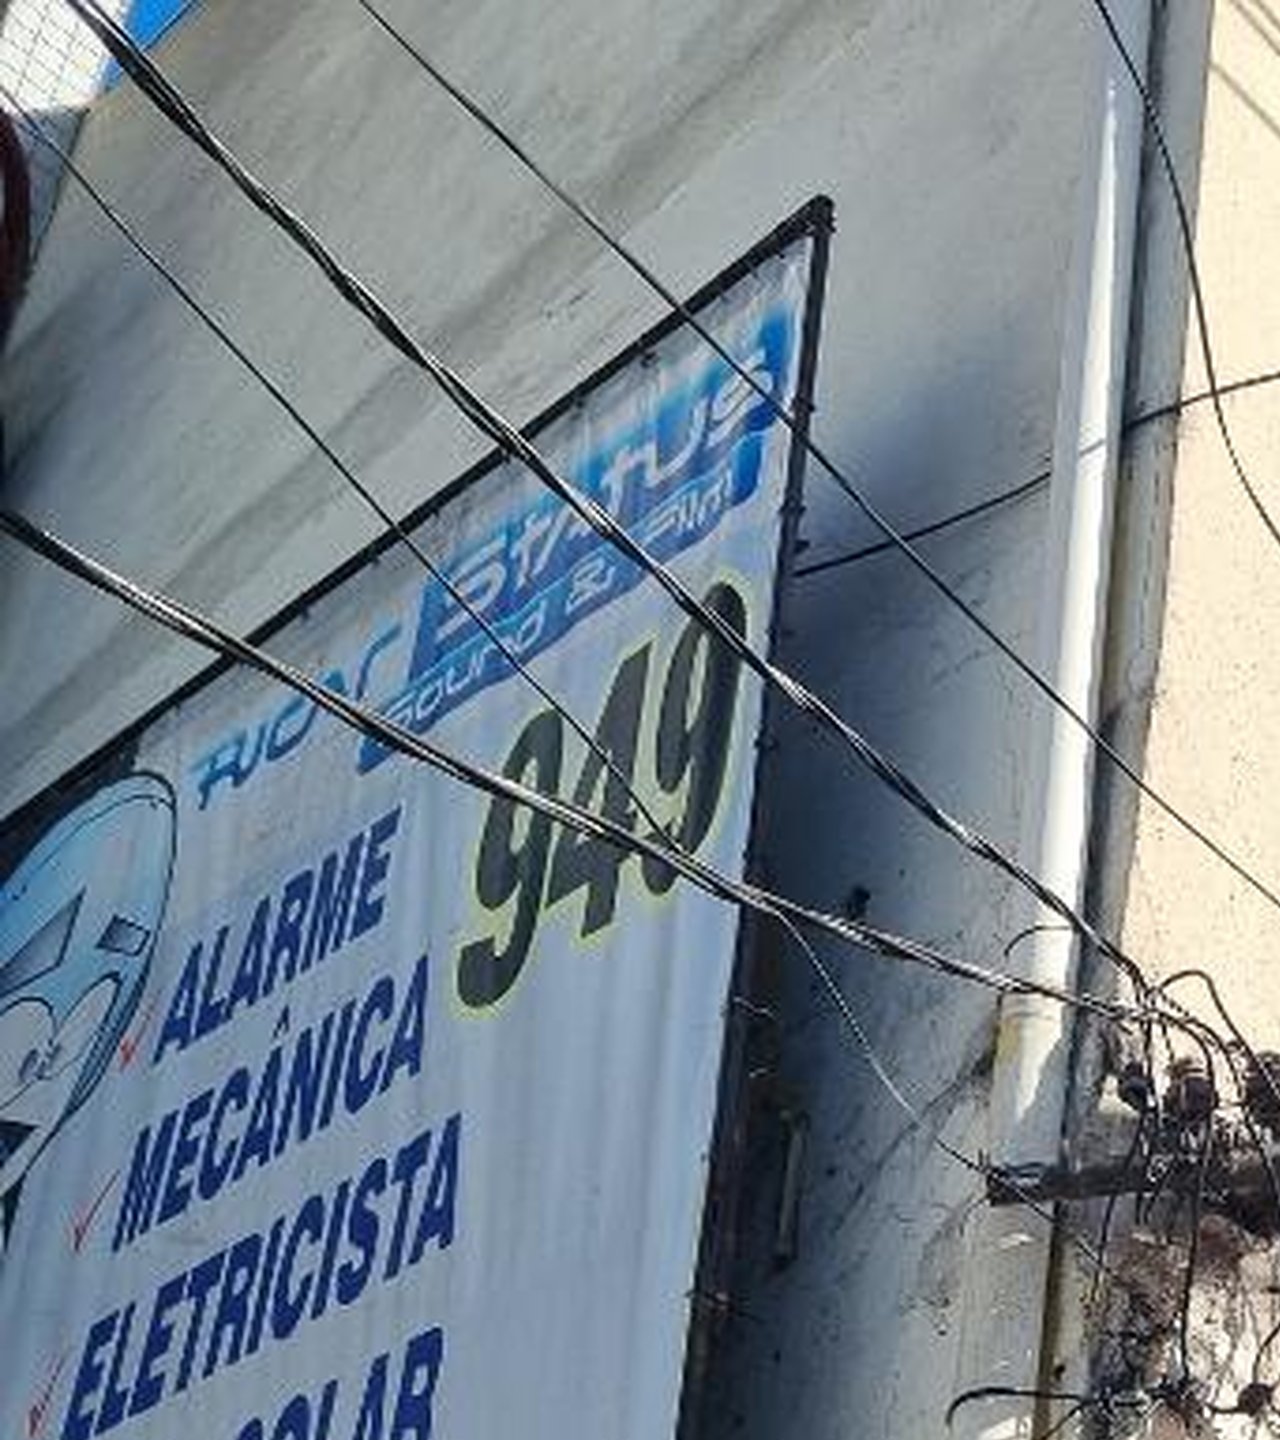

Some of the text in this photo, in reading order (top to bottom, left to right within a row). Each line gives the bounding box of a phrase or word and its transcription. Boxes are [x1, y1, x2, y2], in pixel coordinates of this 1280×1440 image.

[150, 807, 402, 1064] ALARME
[457, 583, 746, 1007] 949
[112, 955, 429, 1252] MECÂNICA
